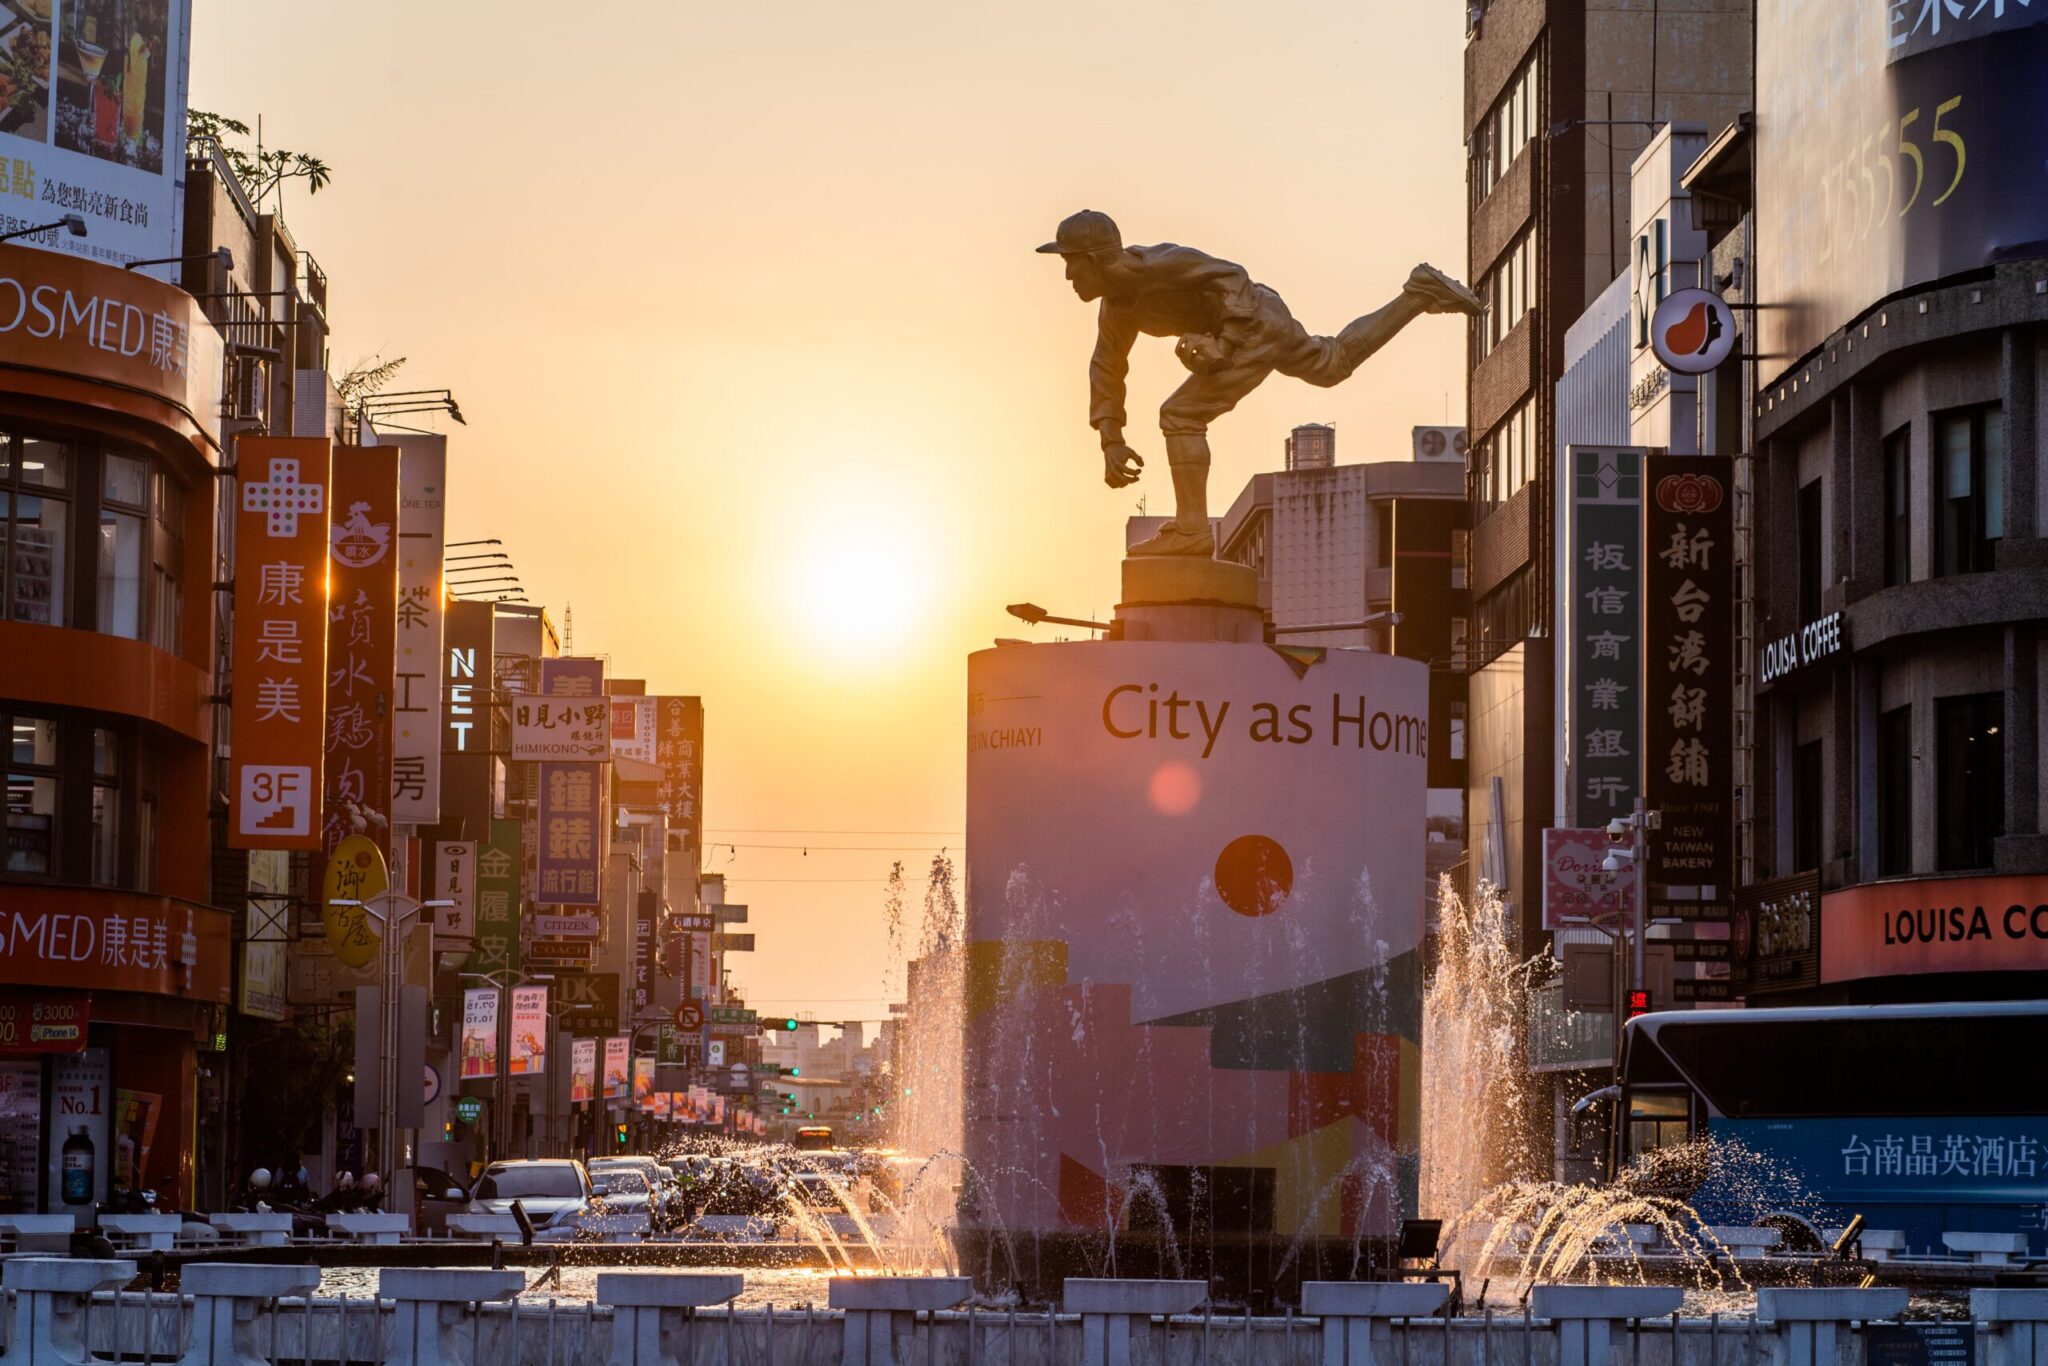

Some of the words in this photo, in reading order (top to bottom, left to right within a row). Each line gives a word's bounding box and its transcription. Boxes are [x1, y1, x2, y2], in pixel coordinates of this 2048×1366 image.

[41, 177, 148, 228] 為您點亮新食尚
[257, 561, 305, 723] 康是美
[1761, 633, 1797, 683] LOUISA
[1802, 611, 1841, 666] COFFEE
[1584, 541, 1632, 807] 板信商業銀行
[450, 647, 475, 751] NET
[516, 704, 607, 730] 日見小野
[1103, 683, 1231, 759] City
[1250, 703, 1313, 745] as
[1332, 693, 1427, 759] Home
[515, 744, 580, 755] HIMIKONO
[991, 728, 1042, 749] CHIAYI
[252, 772, 300, 804] 3F
[675, 739, 695, 820] 商業大樓
[1673, 826, 1704, 837] NEW
[1665, 842, 1714, 852] TAIWAN
[1662, 858, 1714, 869] BAKERY
[542, 868, 594, 894] 流行館
[544, 920, 589, 930] CITIZEN
[1884, 906, 1993, 945] LOUISA
[101, 913, 168, 970] 康是美
[534, 945, 588, 955] COACH
[561, 977, 602, 1001] DK
[44, 1004, 75, 1020] 3000
[42, 1026, 68, 1038] iPhone
[1841, 1134, 2038, 1177] 台南晶英酒店
